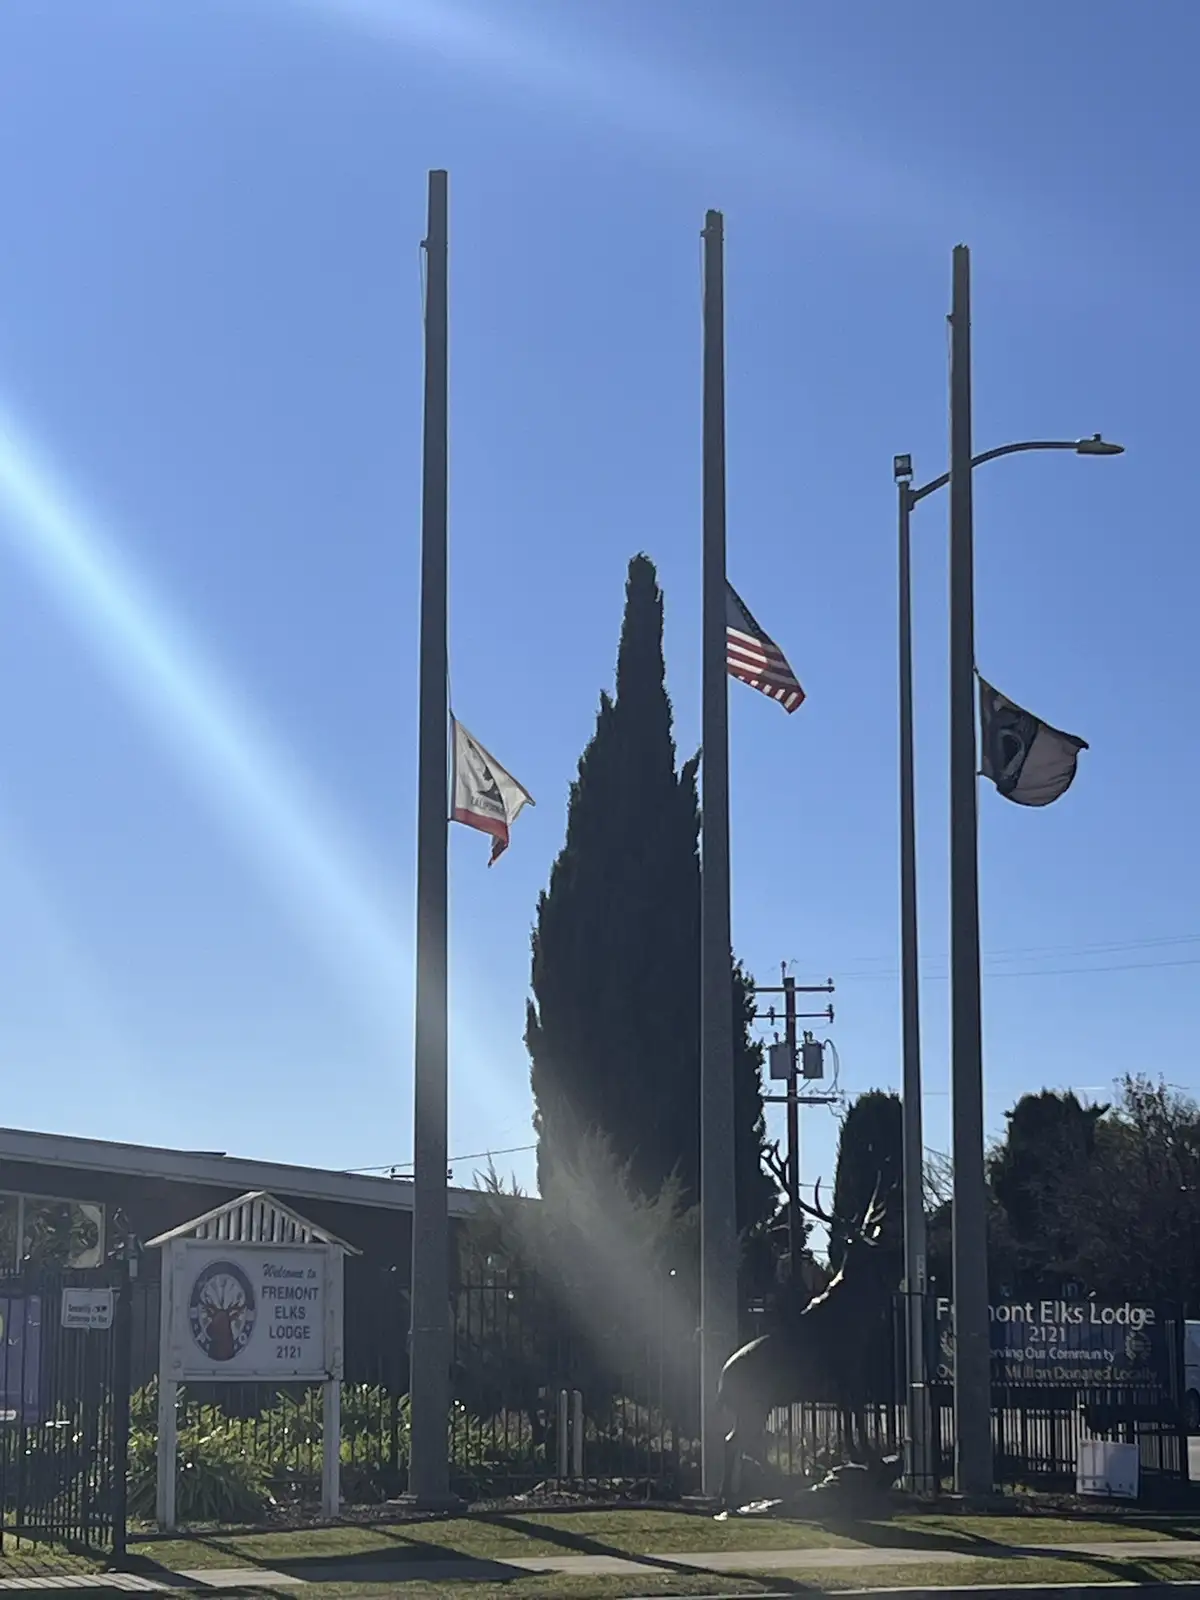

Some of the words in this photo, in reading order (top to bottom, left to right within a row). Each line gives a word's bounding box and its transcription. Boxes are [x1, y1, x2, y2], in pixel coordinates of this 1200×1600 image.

[261, 1285, 319, 1300] FREMONT
[274, 1305, 306, 1320] ELKS
[1039, 1300, 1084, 1324] Elks
[1090, 1302, 1156, 1330] Lodge
[269, 1325, 311, 1339] LODGE
[1028, 1325, 1066, 1342] 2121
[276, 1345, 302, 1359] 2121
[1024, 1346, 1046, 1360] Our
[1048, 1347, 1115, 1363] Communty
[1053, 1366, 1112, 1381] Donated
